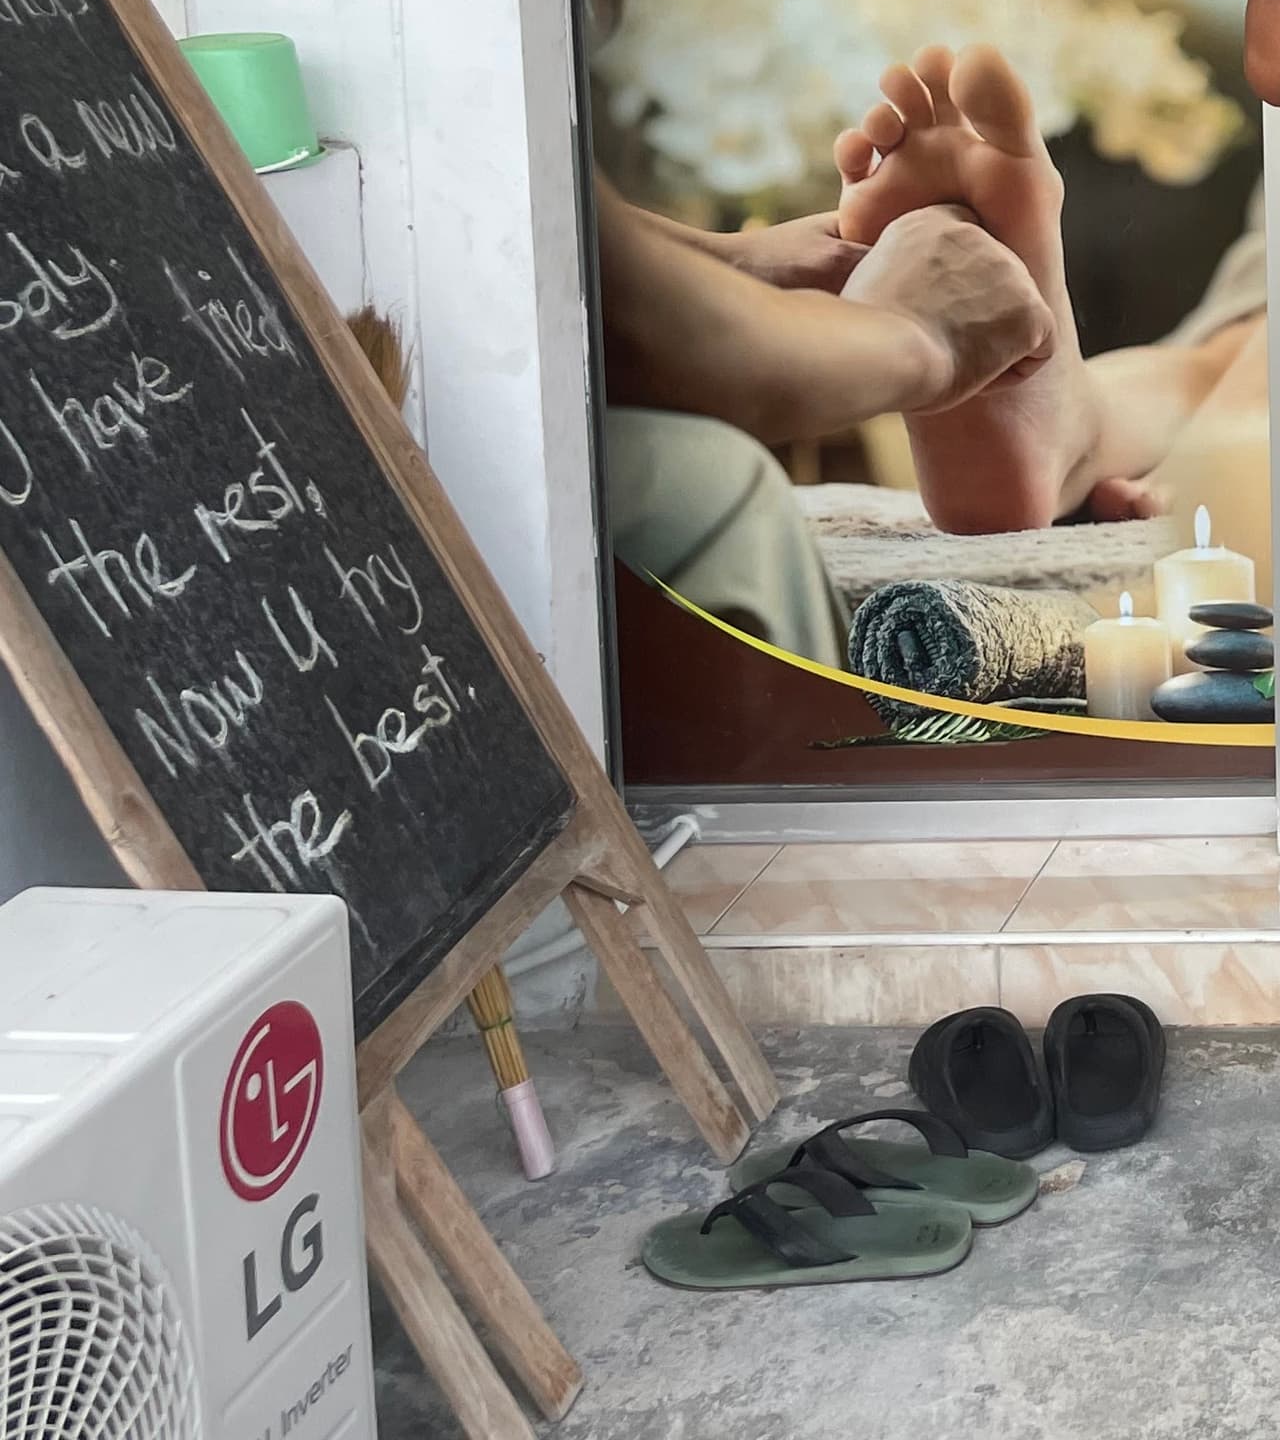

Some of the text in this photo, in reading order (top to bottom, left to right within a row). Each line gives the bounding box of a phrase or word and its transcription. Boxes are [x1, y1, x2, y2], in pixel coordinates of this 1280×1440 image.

[29, 351, 194, 473] have
[41, 518, 198, 639] the
[135, 648, 264, 779] Now
[223, 789, 352, 892] the
[241, 1192, 325, 1342] LG
[280, 1343, 353, 1438] Inverter
